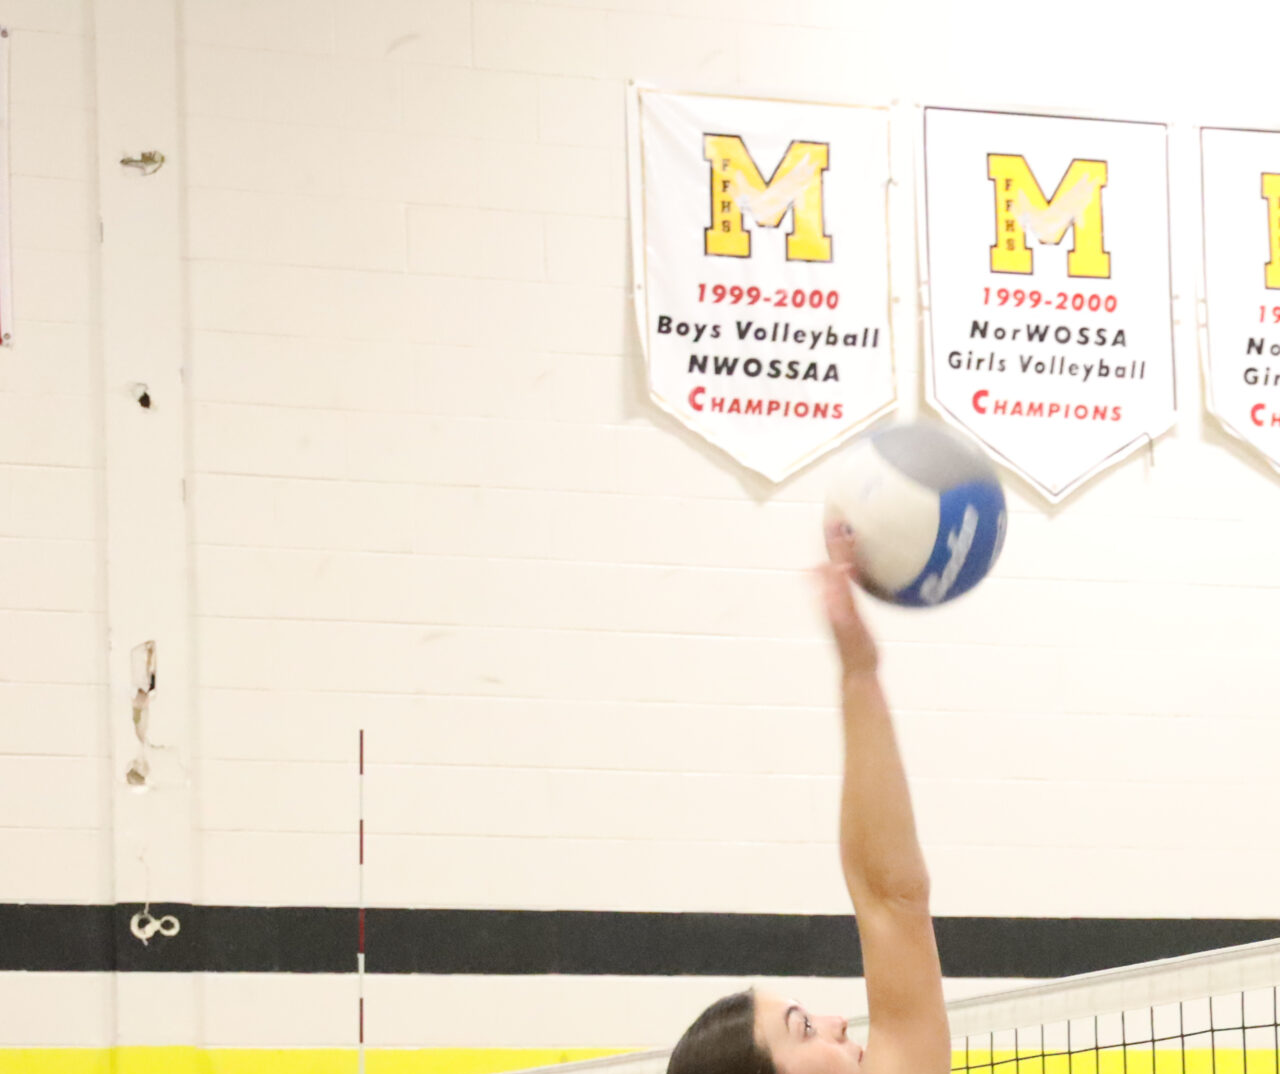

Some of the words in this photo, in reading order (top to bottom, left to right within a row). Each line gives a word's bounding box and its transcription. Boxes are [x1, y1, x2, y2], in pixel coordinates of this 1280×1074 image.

[703, 132, 833, 263] M
[986, 153, 1111, 279] M
[698, 283, 840, 310] 1999-2000
[984, 287, 1118, 313] 1999-2000
[657, 315, 721, 343] Boys
[735, 320, 880, 350] Volleyball
[969, 320, 1126, 348] NorWOSSA
[688, 354, 840, 382] NWOSSAA
[948, 351, 1006, 373] Girls
[1019, 355, 1146, 382] Volleyball
